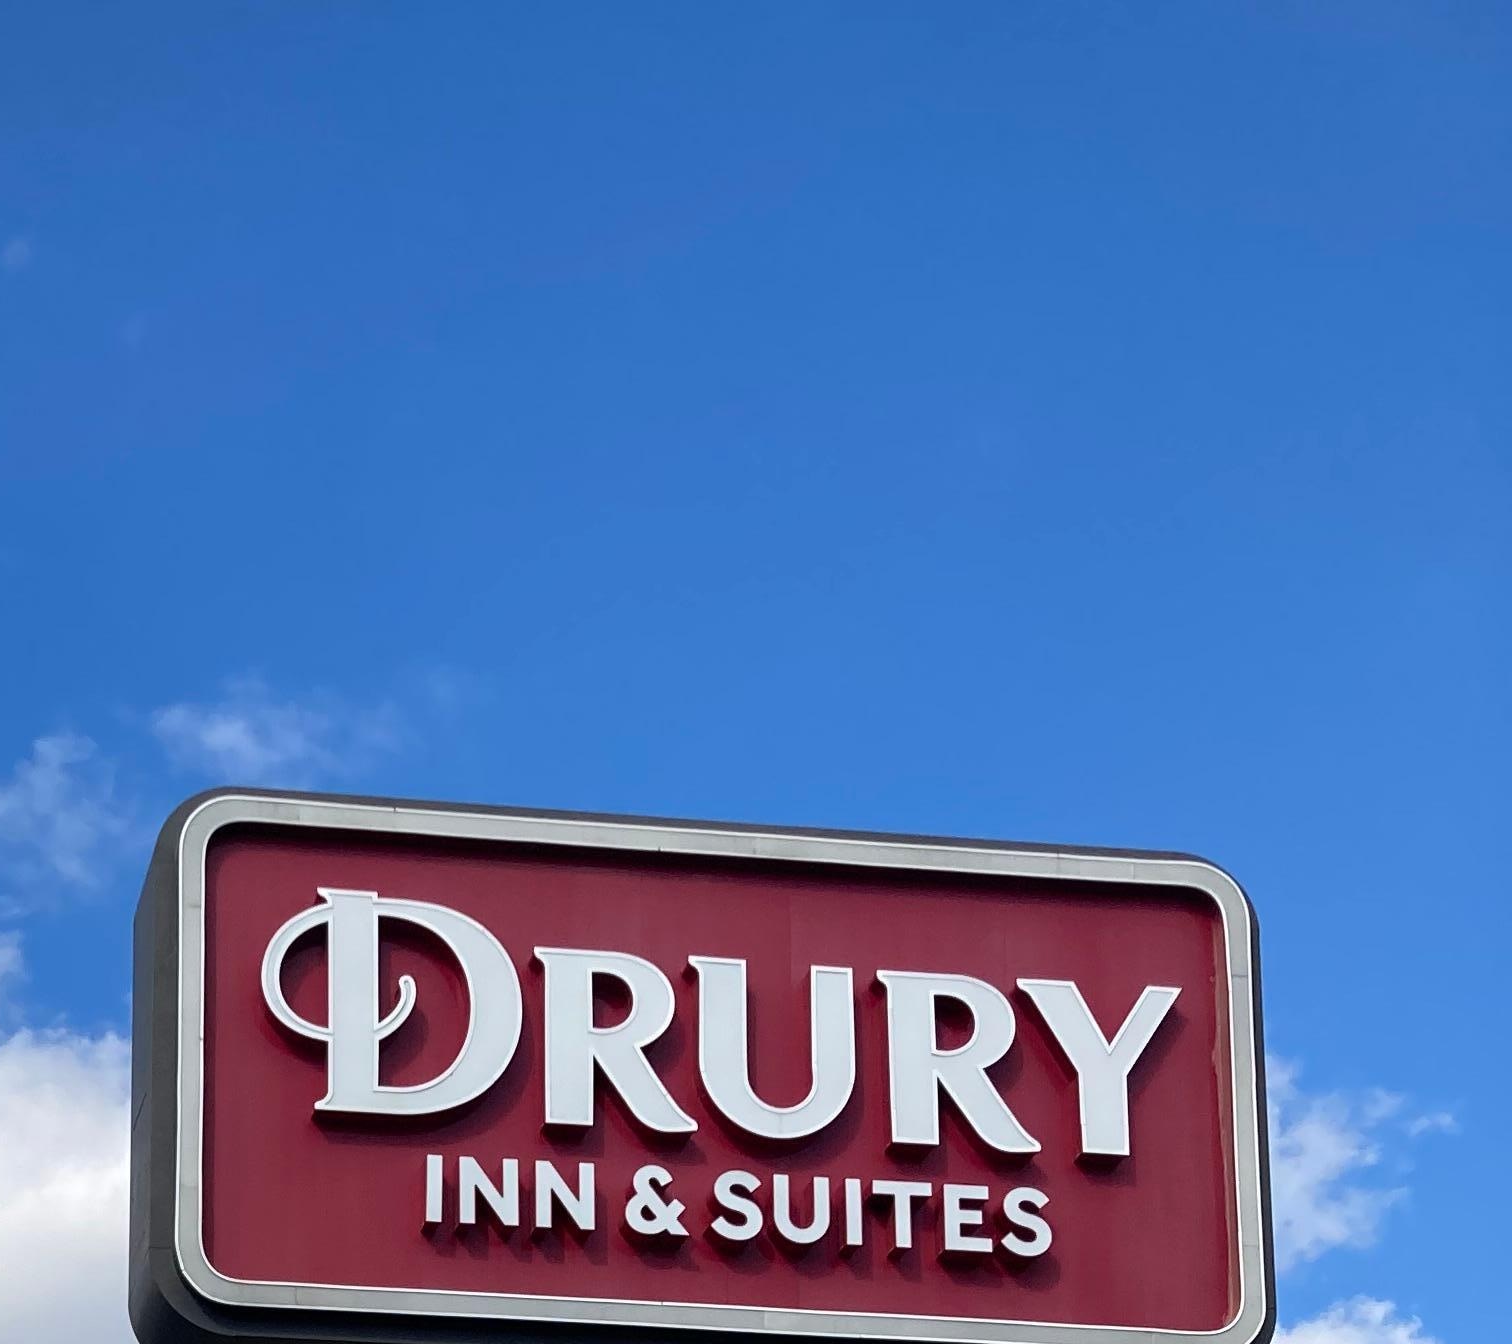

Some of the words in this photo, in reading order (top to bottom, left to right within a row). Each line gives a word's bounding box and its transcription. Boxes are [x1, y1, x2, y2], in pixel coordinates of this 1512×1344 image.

[260, 886, 1183, 1156] DRURY
[424, 1153, 596, 1231] INN
[625, 1164, 690, 1236] &
[711, 1169, 1054, 1257] SUITES
